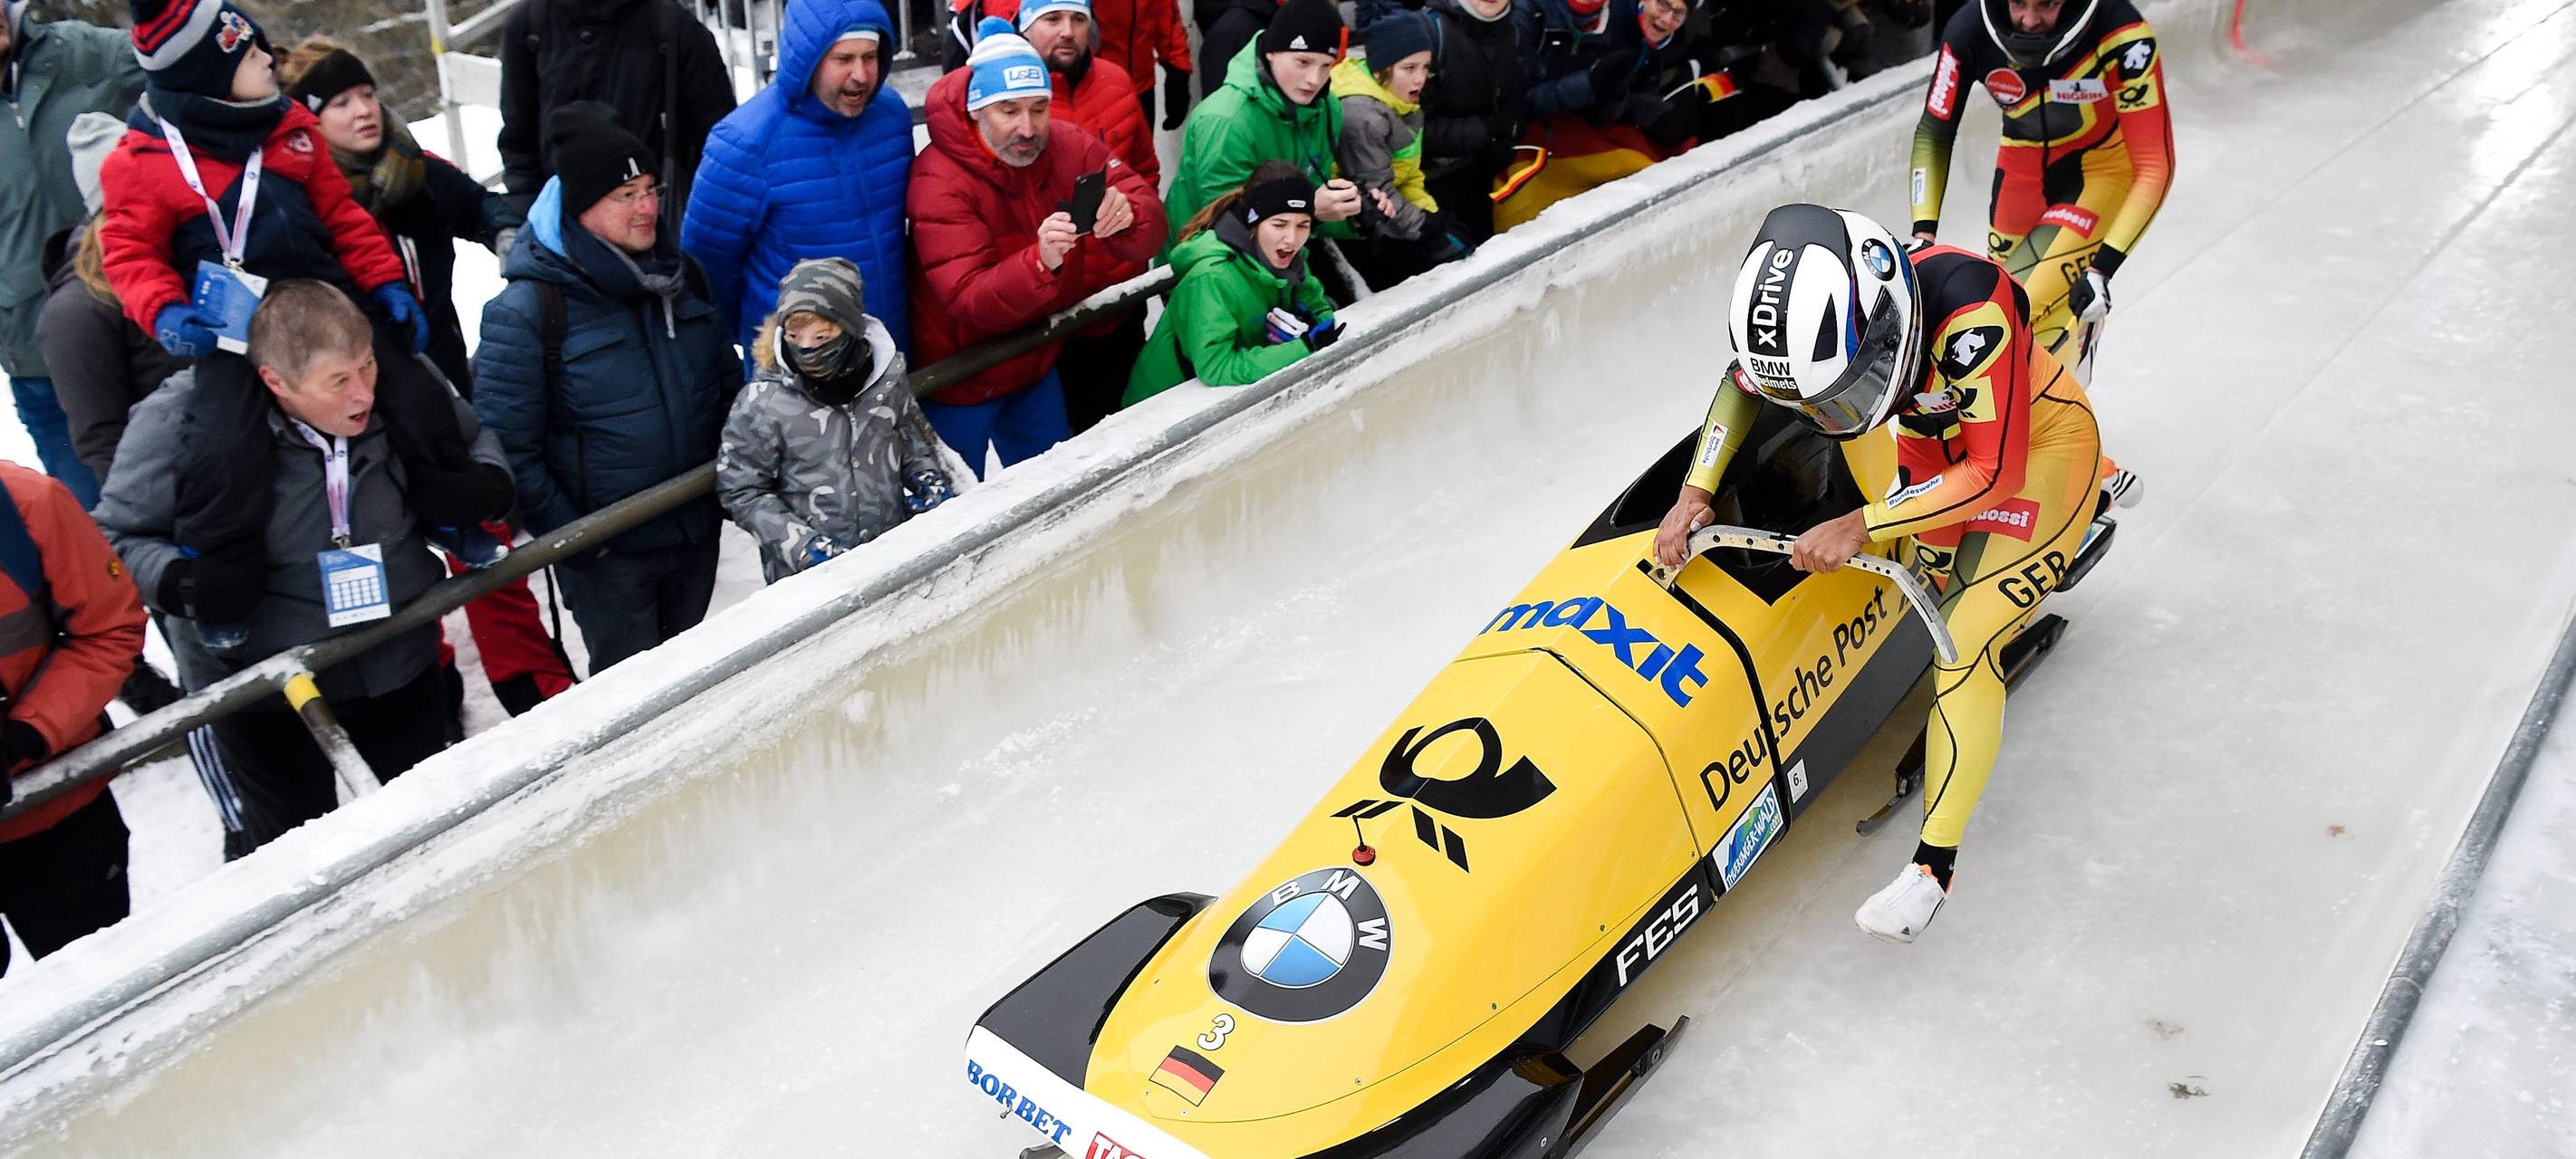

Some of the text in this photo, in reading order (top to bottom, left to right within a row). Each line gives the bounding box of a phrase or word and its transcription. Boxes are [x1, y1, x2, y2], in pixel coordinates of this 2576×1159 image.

[1752, 248, 1794, 349] xDrive
[1750, 358, 1790, 376] BMW
[1755, 373, 1797, 390] helmets
[1889, 478, 1940, 506] Bundeswehr
[1998, 551, 2068, 608] GER
[1477, 596, 1709, 708] maxit
[1832, 585, 1888, 667] Post
[1272, 870, 1388, 951] BMW
[1616, 884, 1699, 987] FES
[1197, 1013, 1235, 1051] 3
[966, 1059, 1072, 1145] BORBET
